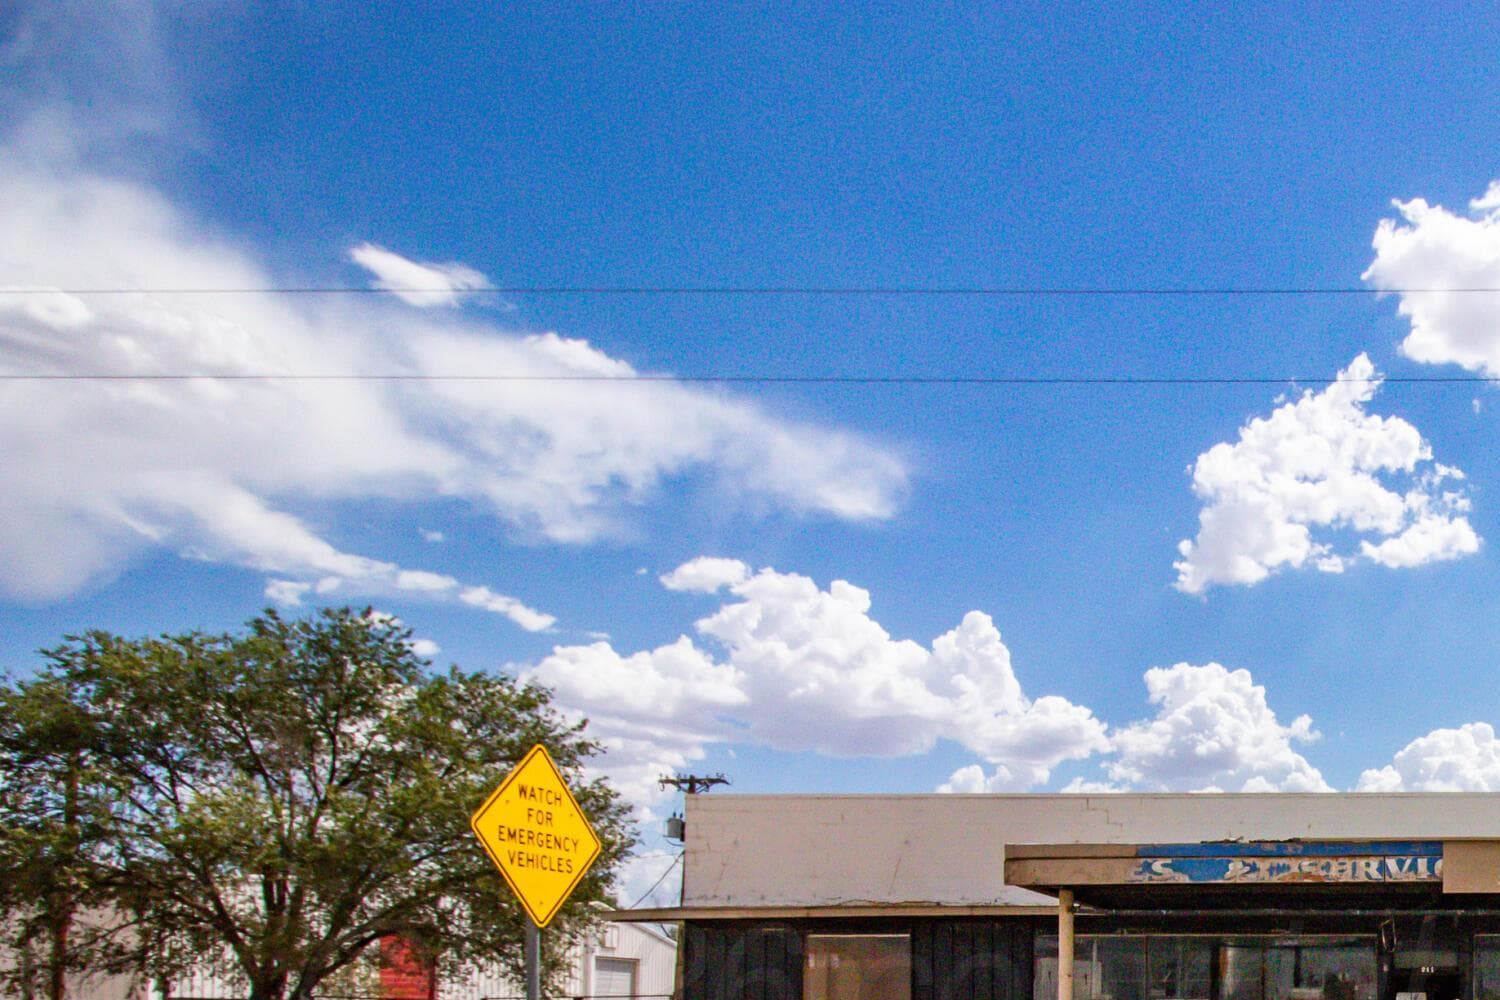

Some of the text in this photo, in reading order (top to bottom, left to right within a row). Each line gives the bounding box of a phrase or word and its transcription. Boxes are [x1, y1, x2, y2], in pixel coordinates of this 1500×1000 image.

[519, 784, 562, 805] WATCH
[527, 808, 553, 826] FOR
[499, 826, 579, 853] EMERGENCY
[508, 851, 573, 874] VEHICLES
